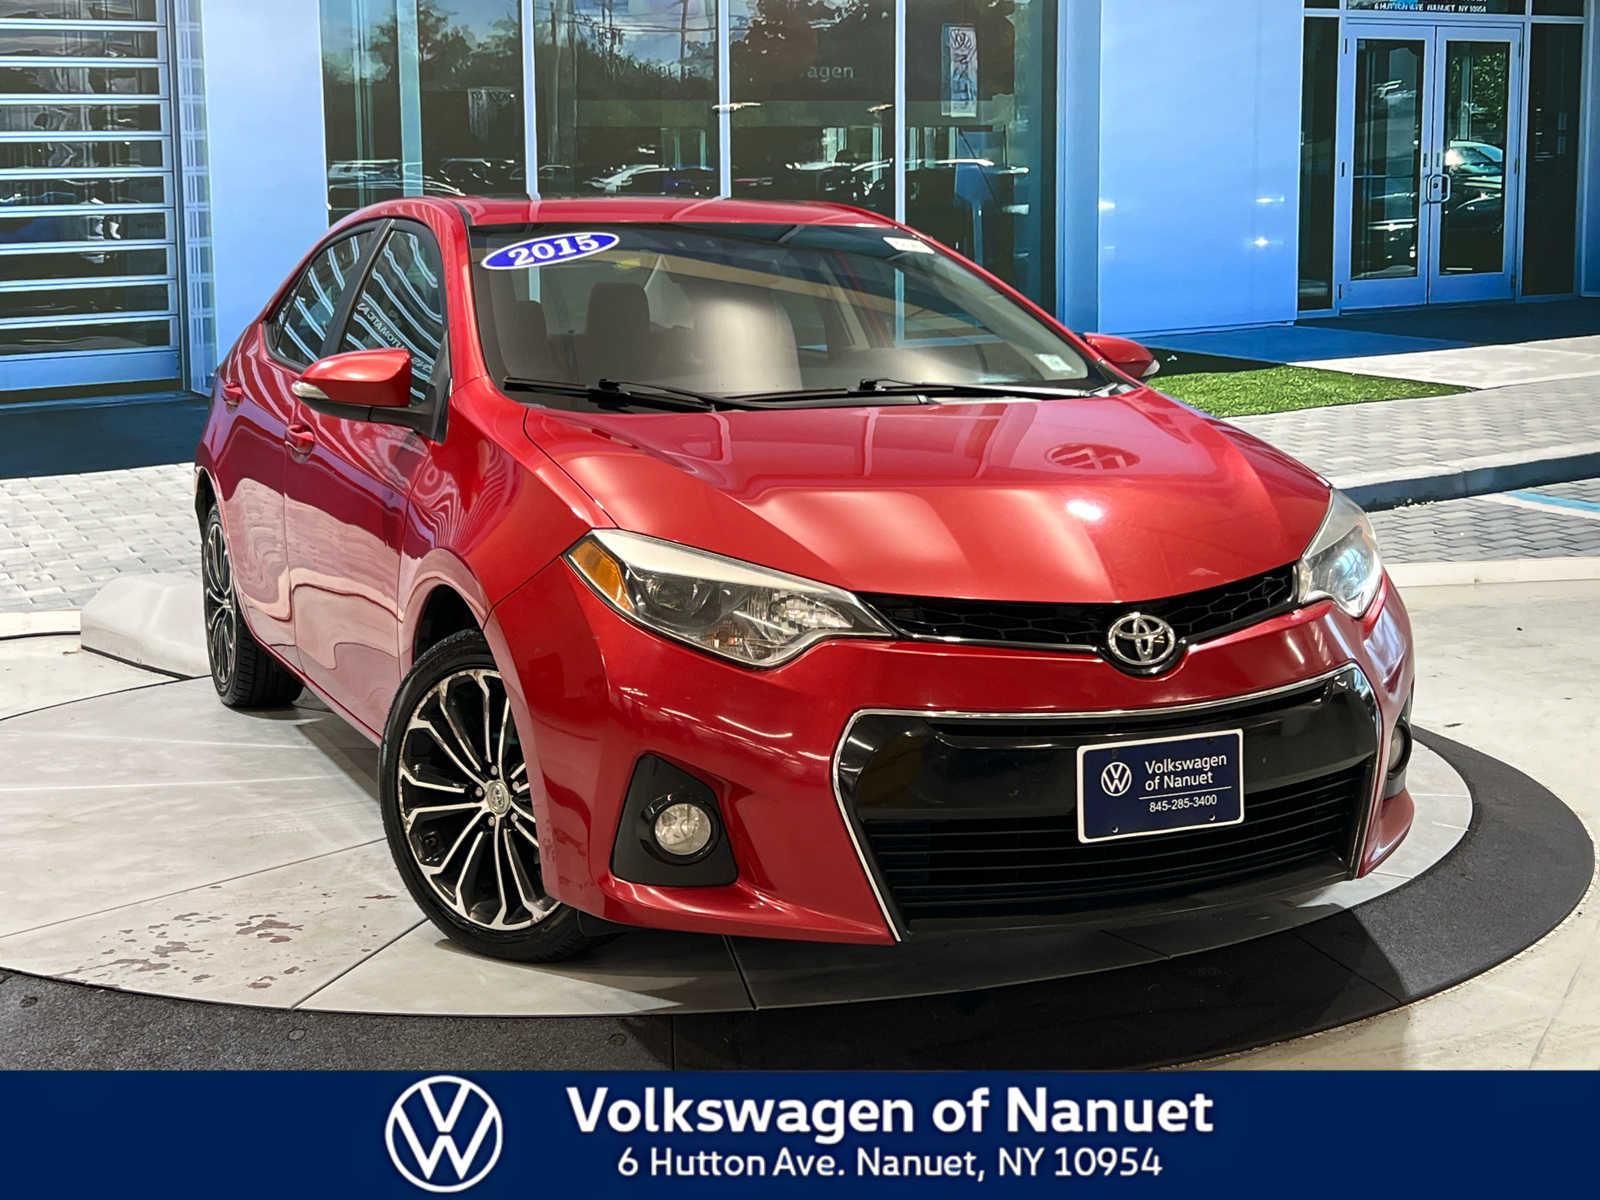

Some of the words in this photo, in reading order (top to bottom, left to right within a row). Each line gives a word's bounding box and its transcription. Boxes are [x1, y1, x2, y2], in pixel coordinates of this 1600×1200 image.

[508, 234, 599, 267] 2015
[1144, 754, 1228, 775] Volkswagen
[1144, 778, 1160, 791] of
[1163, 771, 1213, 790] Nanuet
[1149, 794, 1217, 813] 845-285-3400
